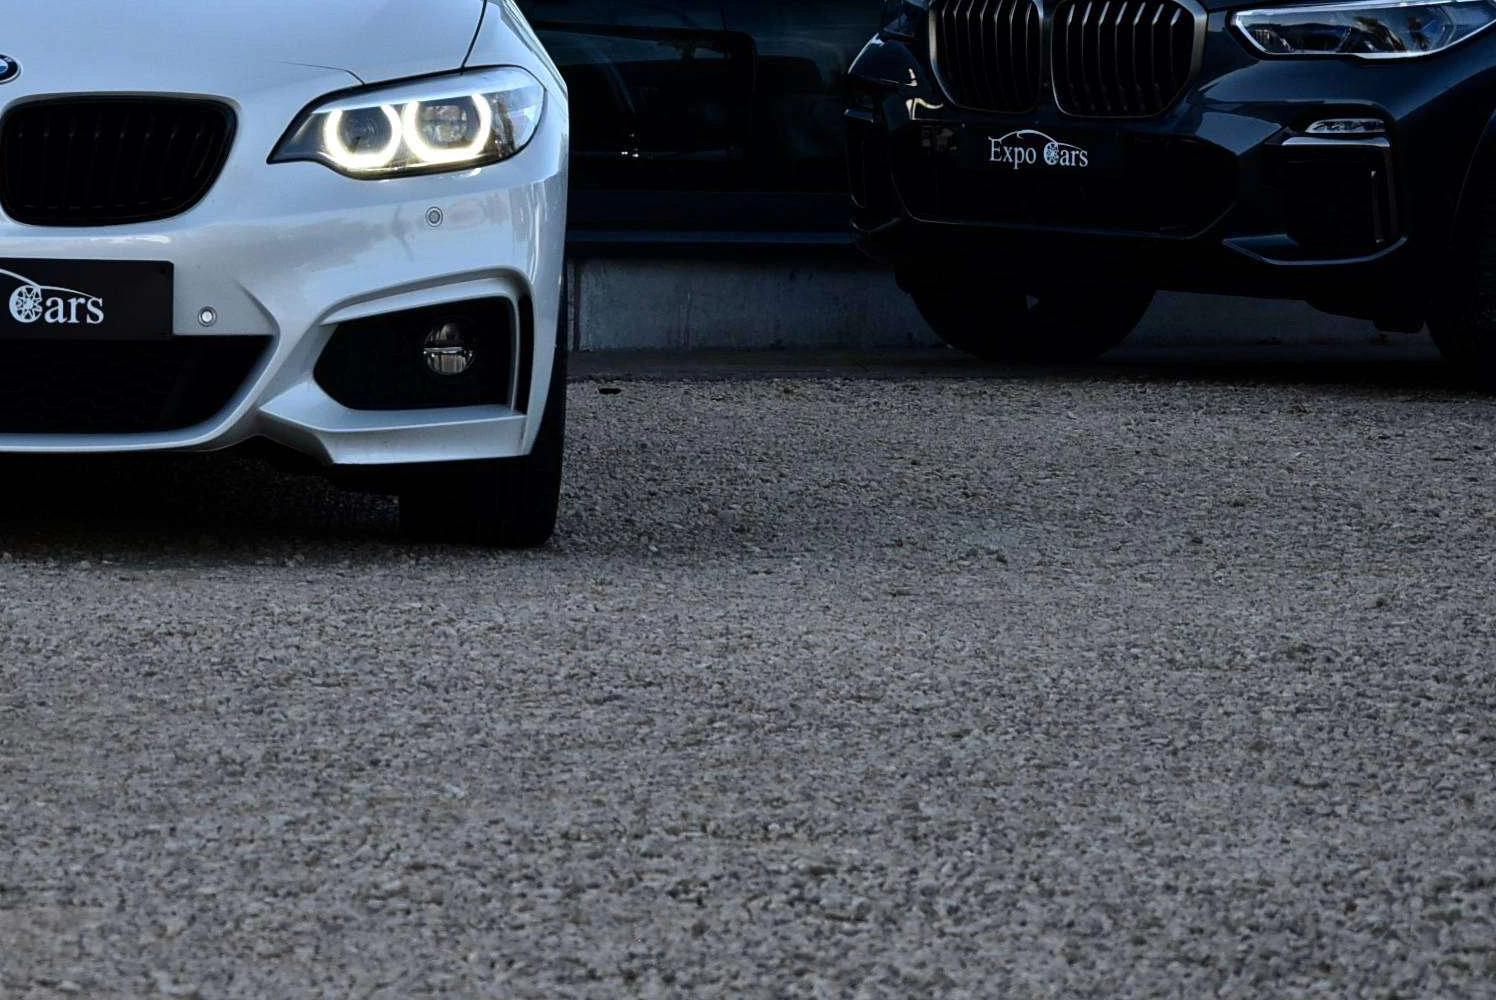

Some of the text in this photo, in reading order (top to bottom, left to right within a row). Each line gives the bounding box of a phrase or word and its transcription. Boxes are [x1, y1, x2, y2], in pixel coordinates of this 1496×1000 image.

[988, 137, 1089, 169] Expo Cars
[8, 285, 104, 324] Cars
